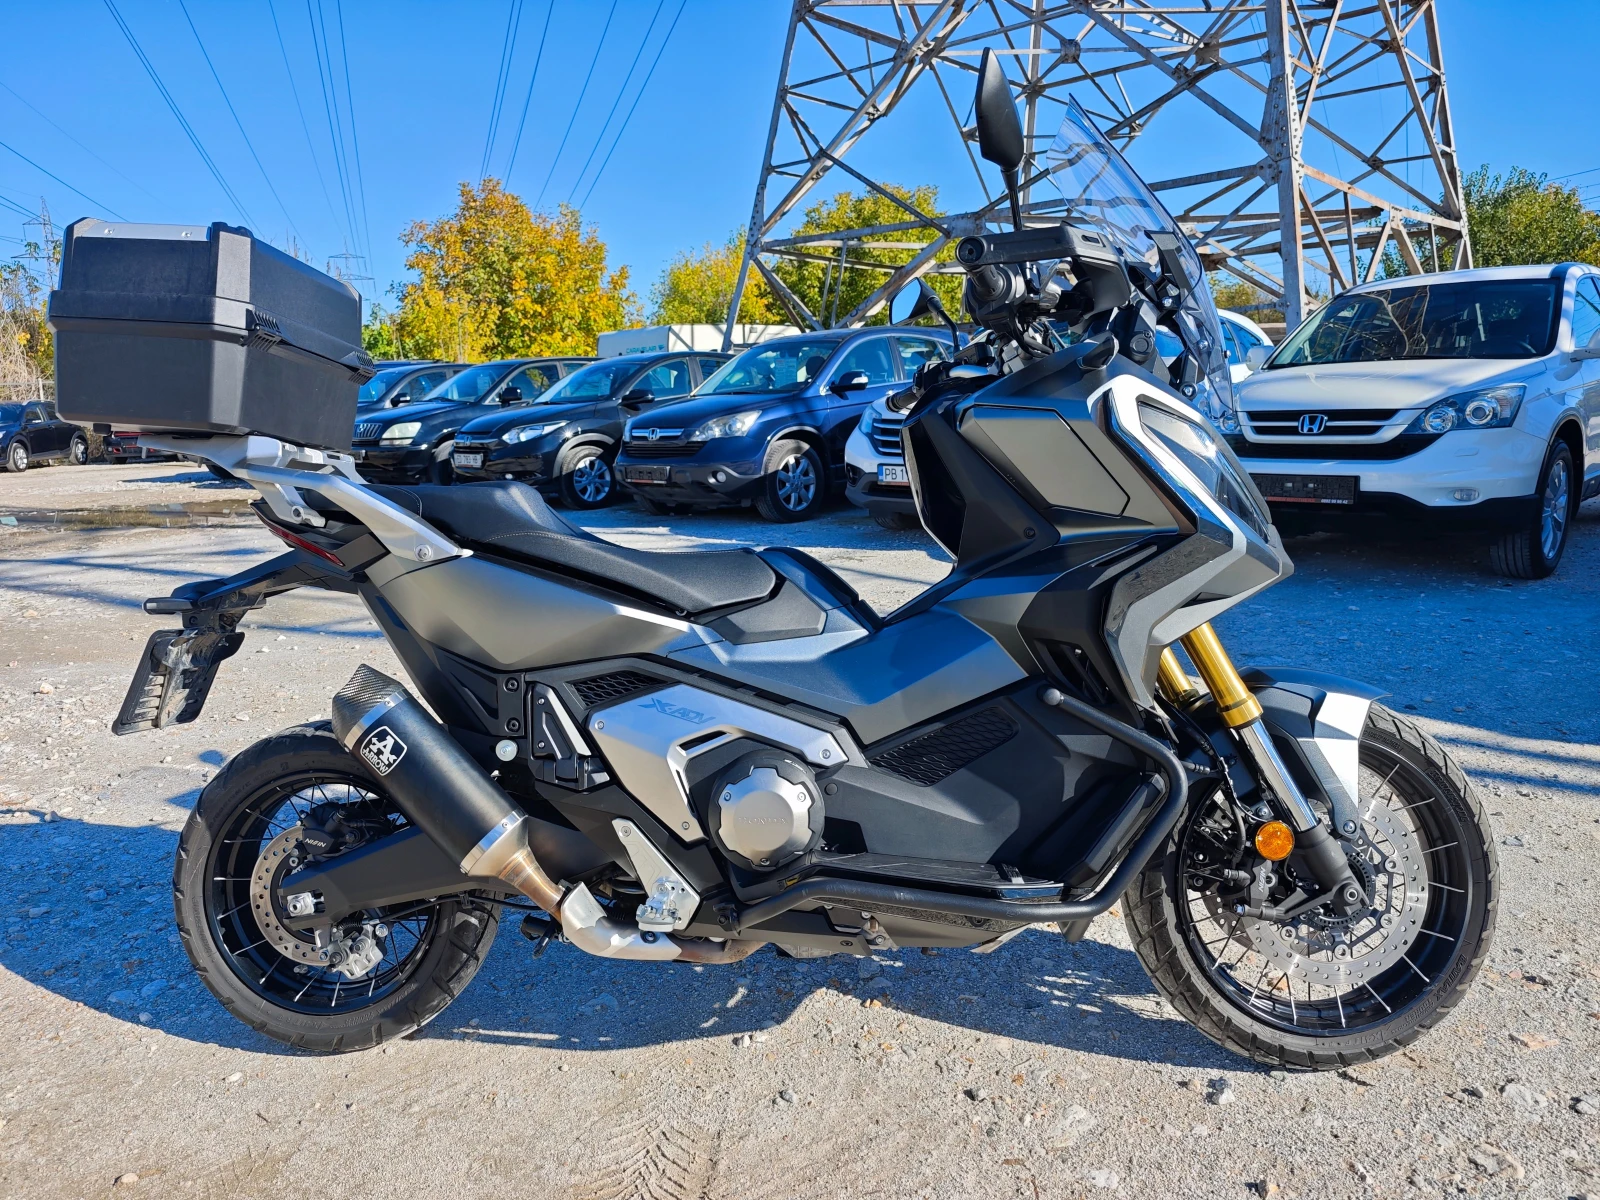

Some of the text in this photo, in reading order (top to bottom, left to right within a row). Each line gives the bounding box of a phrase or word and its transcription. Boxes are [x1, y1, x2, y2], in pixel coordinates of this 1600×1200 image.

[884, 467, 898, 481] PB
[637, 697, 716, 725] X-ADV
[362, 747, 389, 773] ARROW
